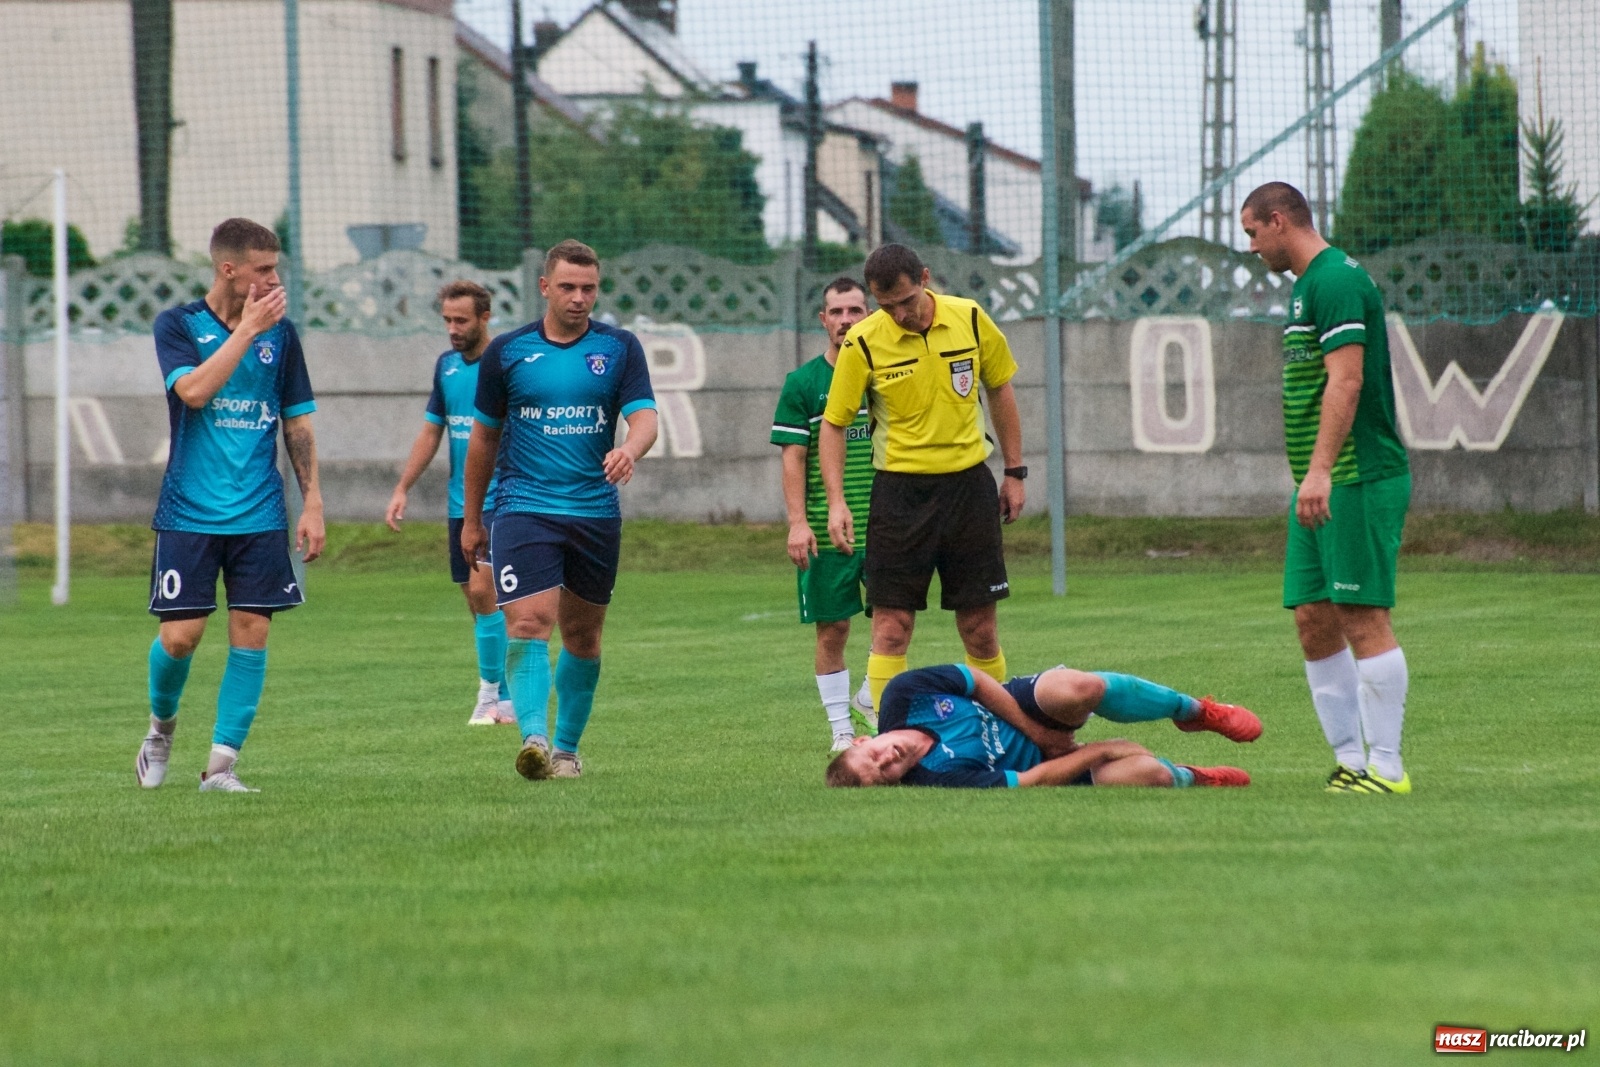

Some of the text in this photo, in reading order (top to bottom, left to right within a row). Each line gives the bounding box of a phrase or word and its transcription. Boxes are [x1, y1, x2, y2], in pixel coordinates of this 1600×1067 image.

[1385, 310, 1565, 451] W
[211, 398, 257, 412] SPORT
[520, 406, 594, 419] MW SPORT
[214, 416, 256, 430] acibórz
[543, 423, 593, 435] Racibórz
[158, 569, 181, 600] 10
[500, 564, 518, 593] 6
